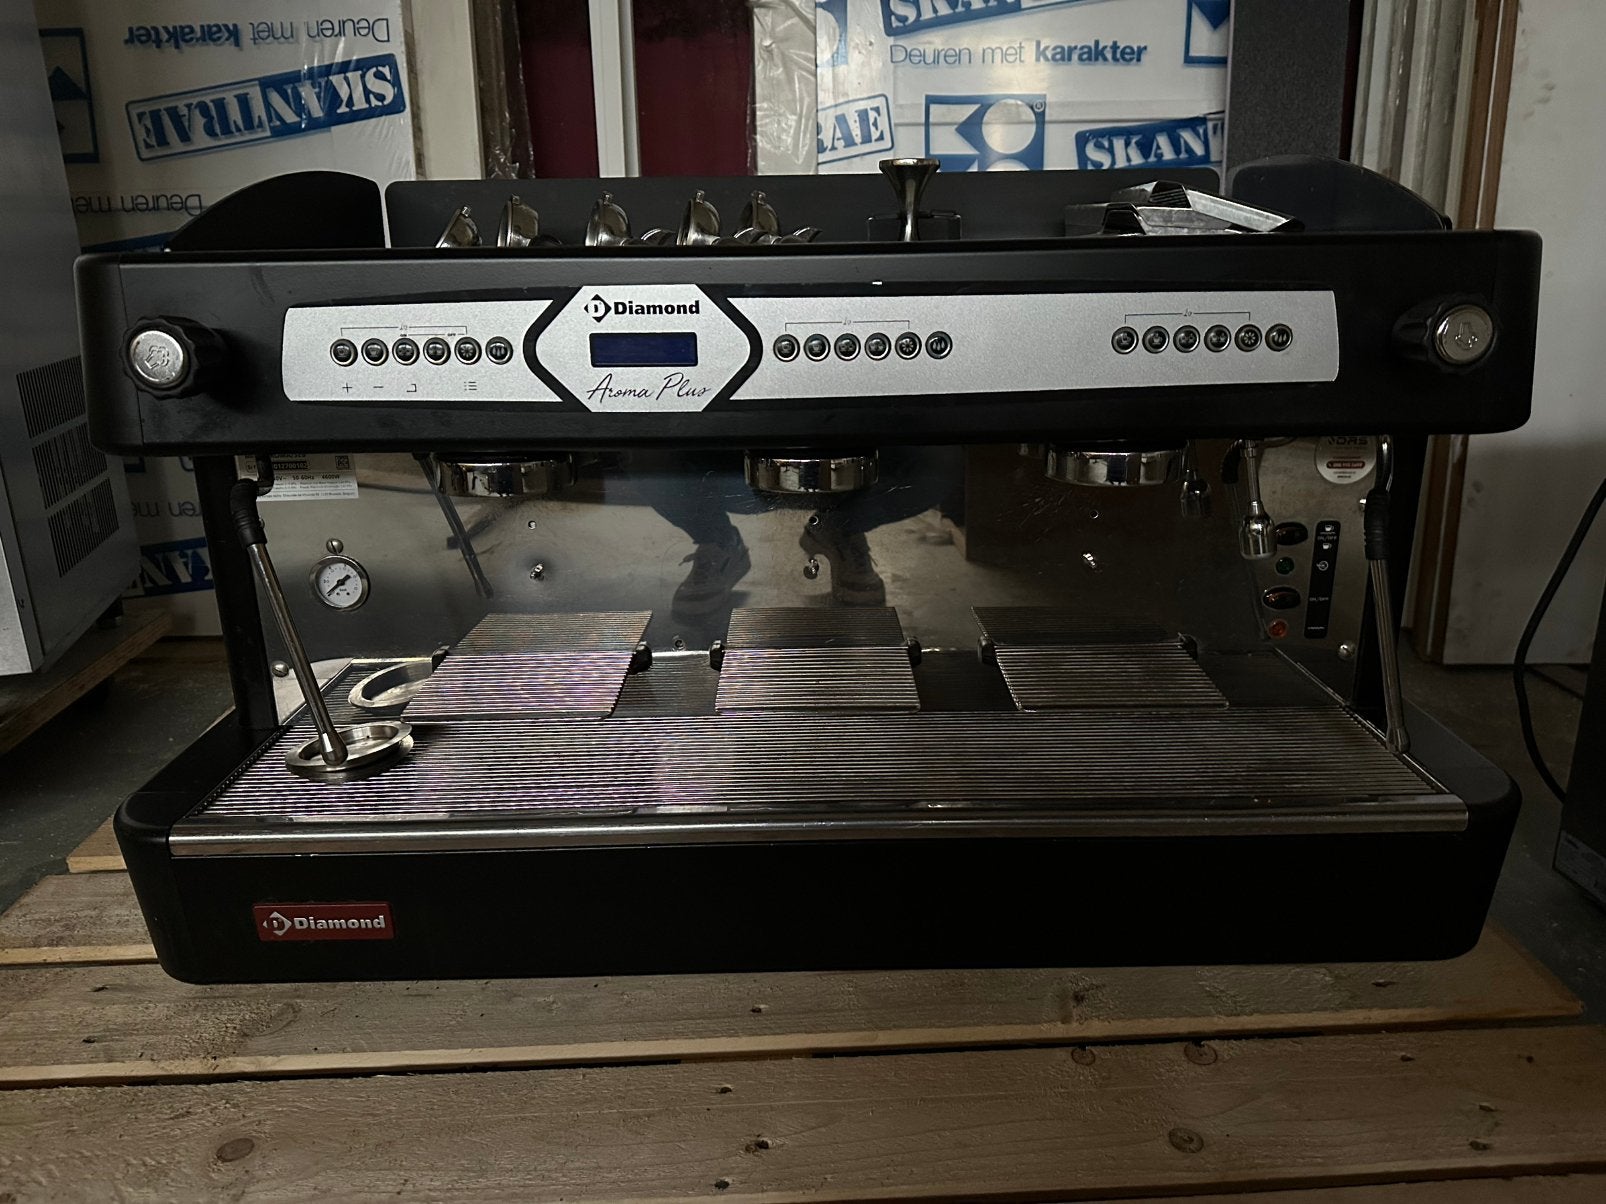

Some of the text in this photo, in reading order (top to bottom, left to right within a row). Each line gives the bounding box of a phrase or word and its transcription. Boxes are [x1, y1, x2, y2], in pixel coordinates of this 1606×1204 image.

[124, 17, 391, 49] Deuren met karakter
[889, 39, 1148, 66] Deuren met karakter
[135, 64, 396, 149] SKANTRAE
[120, 193, 203, 217] Deuren
[613, 300, 700, 315] Diamond
[586, 371, 712, 404] Aroma Plus
[293, 914, 386, 930] Diamond
